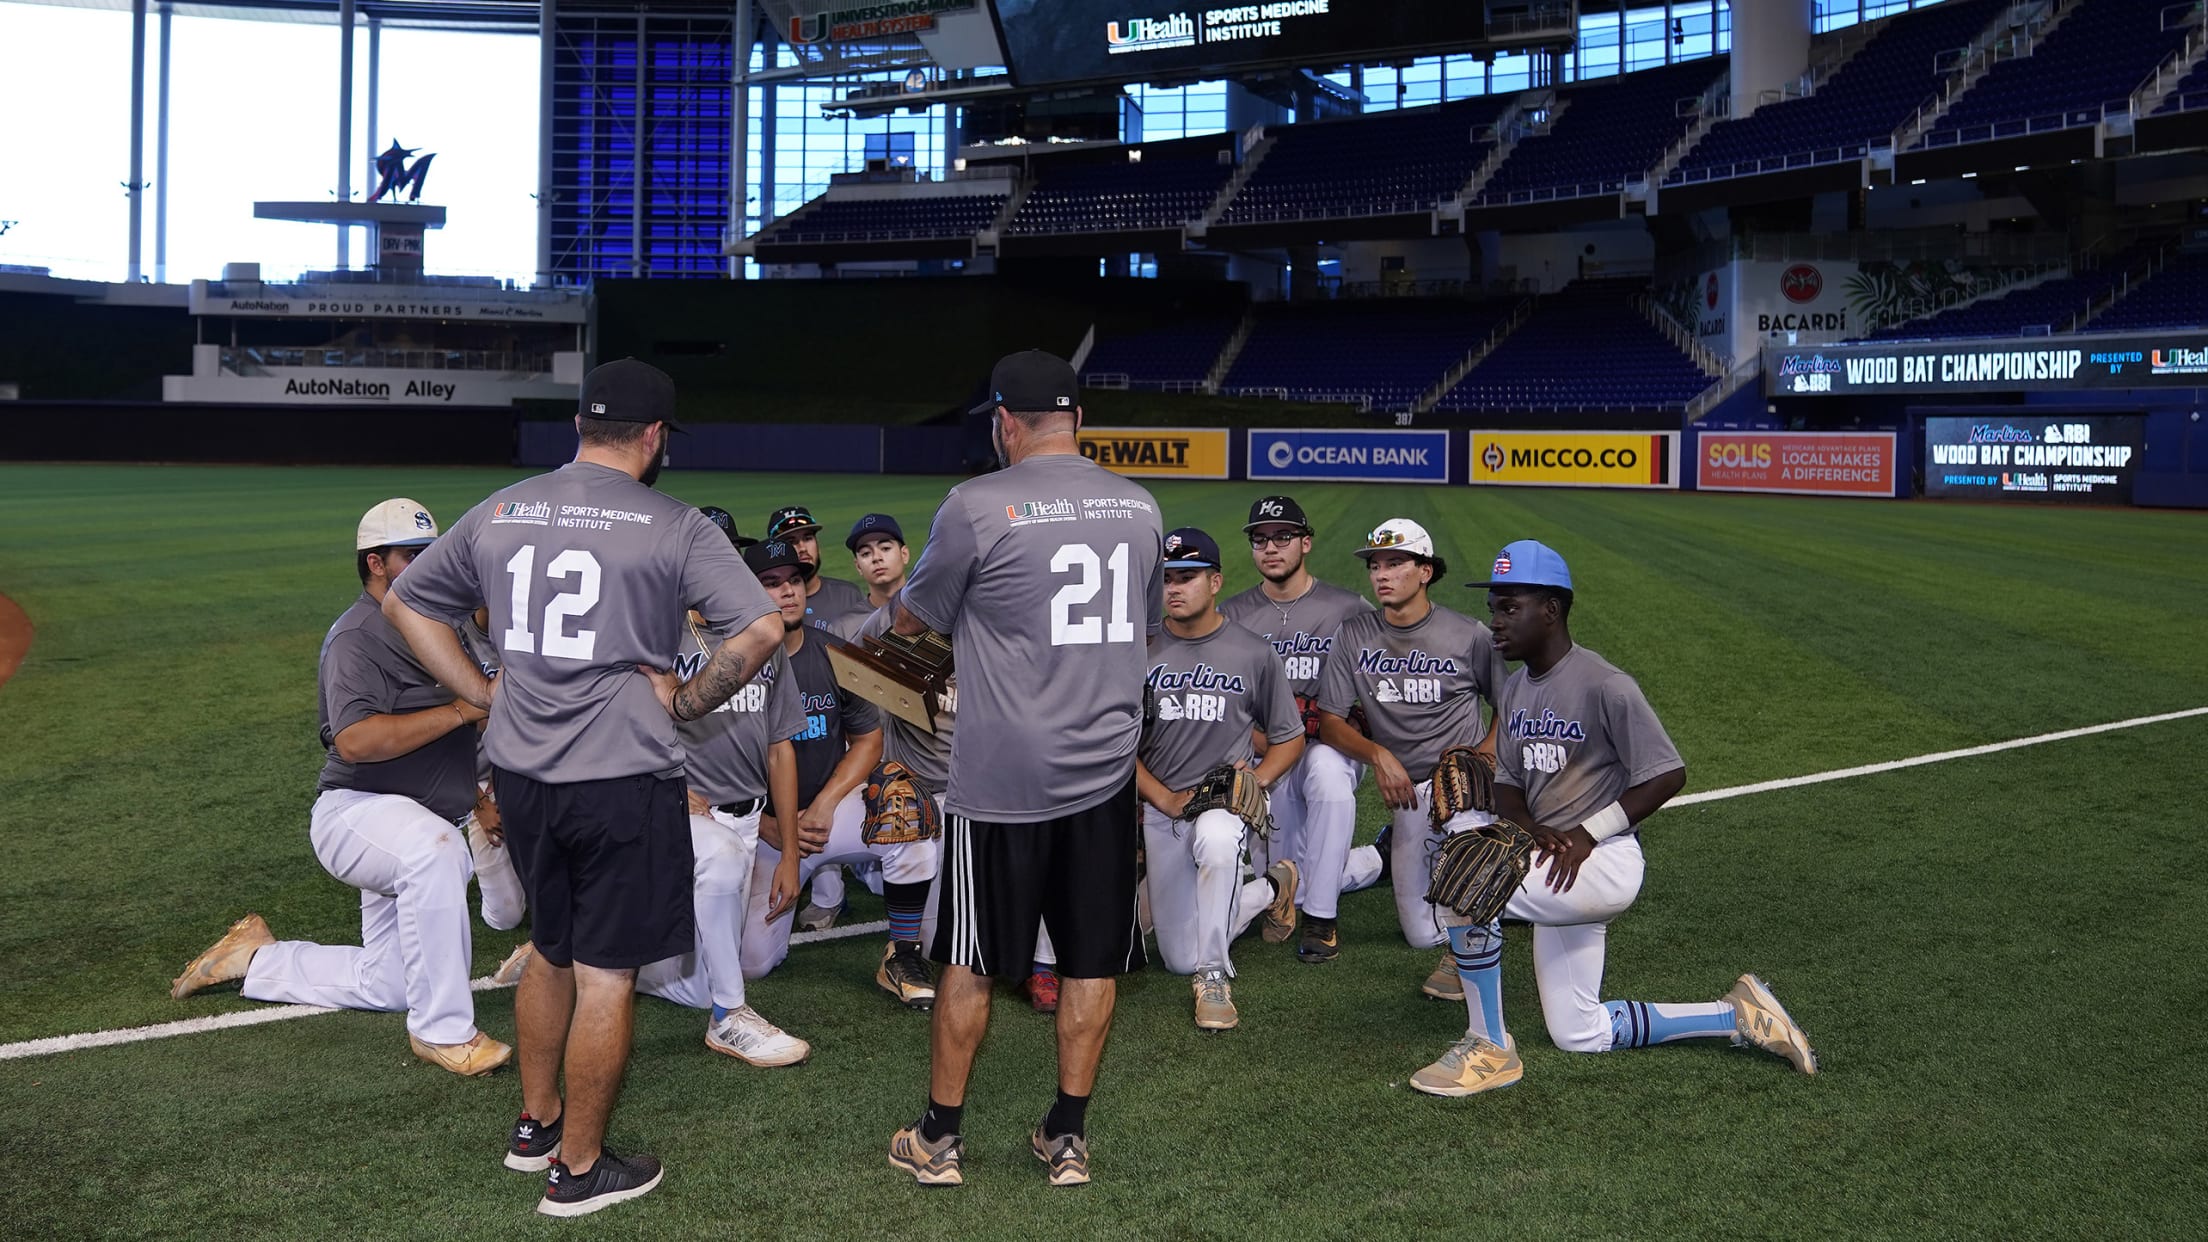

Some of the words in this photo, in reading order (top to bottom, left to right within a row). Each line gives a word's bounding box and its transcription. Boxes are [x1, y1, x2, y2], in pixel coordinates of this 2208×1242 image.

[832, 3, 908, 24] UNIVERSITY
[1107, 12, 1194, 44] UHealth
[1206, 7, 1258, 25] SPORTS
[1261, 0, 1329, 20] MEDICINE
[831, 19, 880, 39] HEALTH
[880, 15, 933, 34] SYSTEM
[1206, 22, 1281, 42] INSTITUTE
[908, 75, 925, 88] 42
[230, 300, 289, 311] AutoNation
[308, 303, 364, 313] PROUD
[374, 304, 462, 316] PARTNERS
[1758, 307, 1847, 332] BACARDÍ
[1779, 354, 1841, 376] Marlins
[1846, 357, 1897, 384] WOOD
[1903, 355, 1935, 383] BAT
[1941, 350, 2082, 382] CHAMPIONSHIP
[2090, 351, 2143, 364] PRESENTED
[2110, 363, 2123, 374] BY
[285, 378, 389, 397] AutoNation
[405, 380, 456, 400] Alley
[1809, 374, 1832, 392] RBI
[1395, 412, 1413, 426] 387
[1968, 424, 2032, 443] Marlins
[2063, 424, 2090, 443] RBI
[1297, 447, 1368, 465] OCEAN
[1373, 448, 1428, 467] BANK
[1511, 447, 1637, 468] MICCO.CO
[1709, 442, 1772, 469] SOLIS
[1782, 453, 1826, 465] LOCAL
[1830, 453, 1881, 467] MAKES
[1933, 445, 1978, 465] WOOD
[1981, 445, 2010, 466] BAT
[2014, 446, 2132, 468] CHAMPIONSHIP
[1711, 471, 1741, 480] HEALTH
[1743, 471, 1767, 481] PLANS
[1781, 467, 1791, 480] A
[1794, 467, 1880, 482] DIFFERENCE
[1944, 475, 1986, 485] PRESENTED
[1987, 476, 1997, 486] BY
[2002, 472, 2048, 487] UHealth
[2053, 474, 2080, 484] SPORTS
[2082, 474, 2117, 485] MEDICINE
[2053, 484, 2092, 493] INSTITUTE
[494, 501, 551, 519] UHealth
[560, 505, 599, 518] SPORTS
[600, 507, 653, 525] MEDICINE
[1006, 498, 1076, 521] UHealth
[1083, 499, 1118, 508] SPORTS
[1119, 499, 1153, 514] MEDICINE
[1084, 509, 1133, 519] INSTITUTE
[1258, 500, 1284, 517] HG
[557, 517, 613, 531] INSTITUTE
[504, 544, 602, 660] 12
[1050, 542, 1134, 646] 21
[1285, 656, 1320, 680] RBI
[1355, 648, 1459, 677] Marlins
[1403, 678, 1441, 704] RBI
[1186, 694, 1226, 722] RBI
[1509, 708, 1586, 742] Marlins
[1534, 742, 1568, 774] RBI
